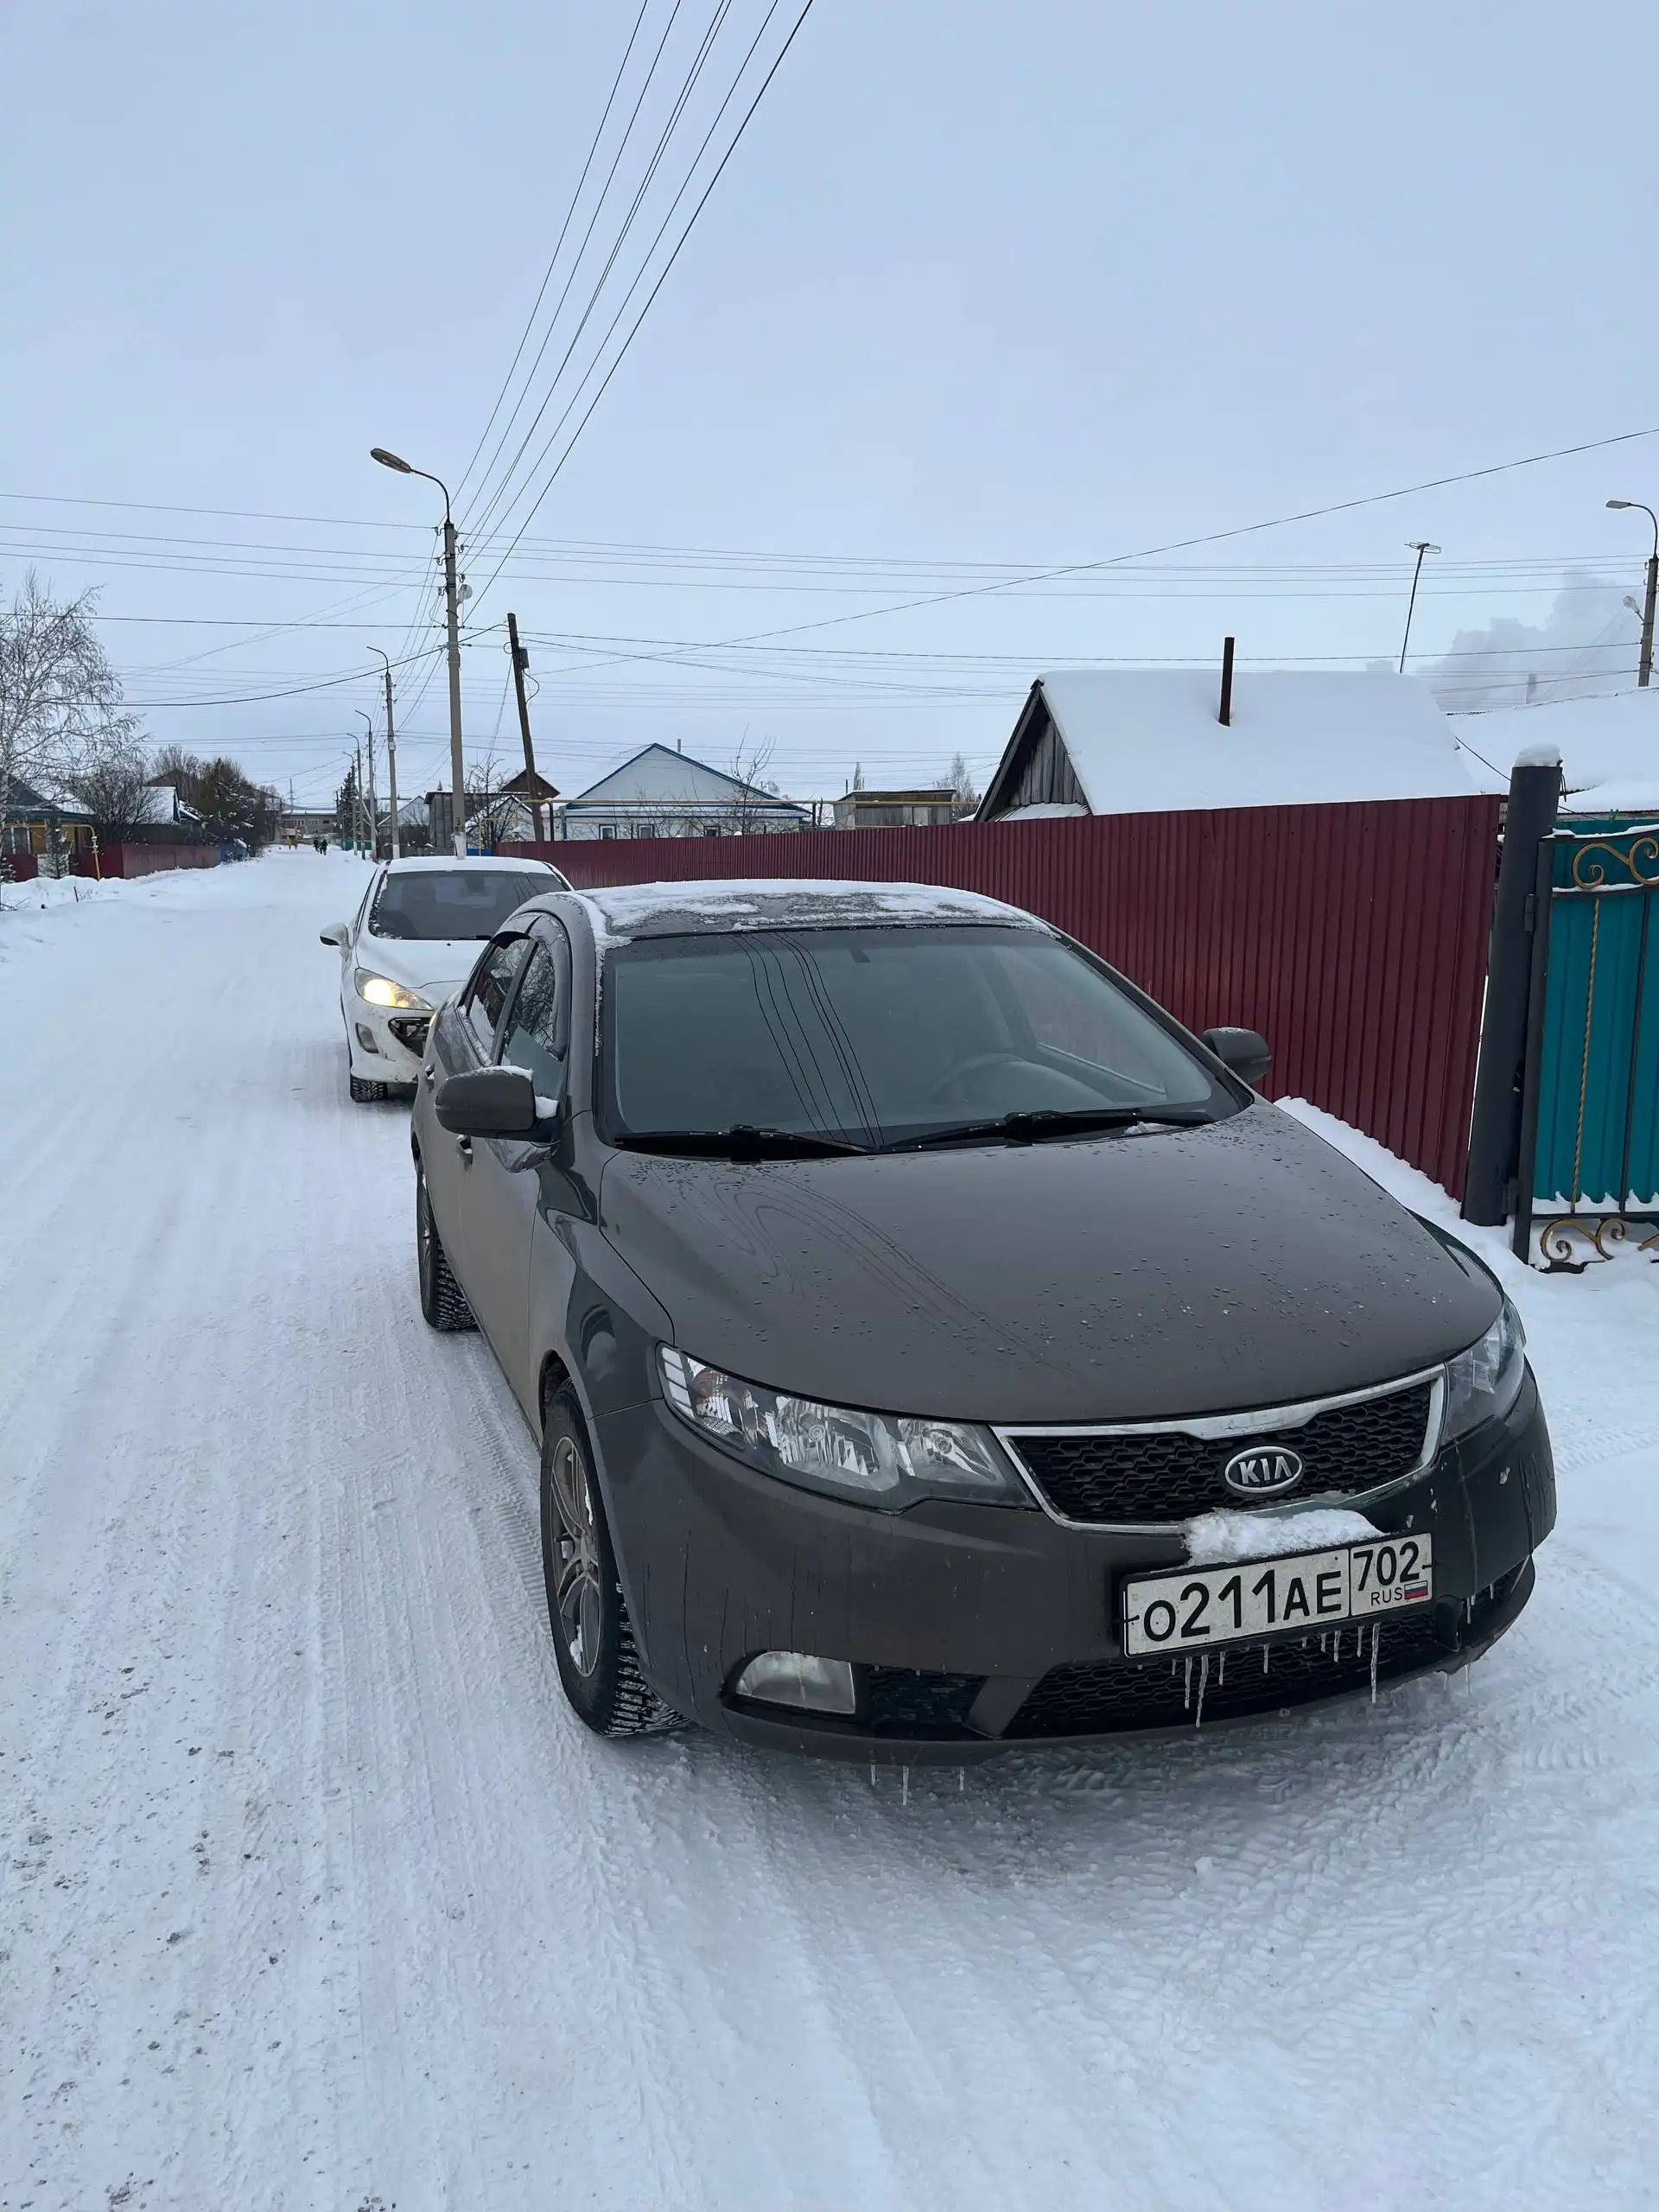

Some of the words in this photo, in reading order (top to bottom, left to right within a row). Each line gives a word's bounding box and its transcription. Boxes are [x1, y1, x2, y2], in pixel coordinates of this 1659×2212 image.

[1237, 1455, 1293, 1484] KIA
[1352, 1541, 1420, 1592] 702
[1370, 1586, 1403, 1606] RUS
